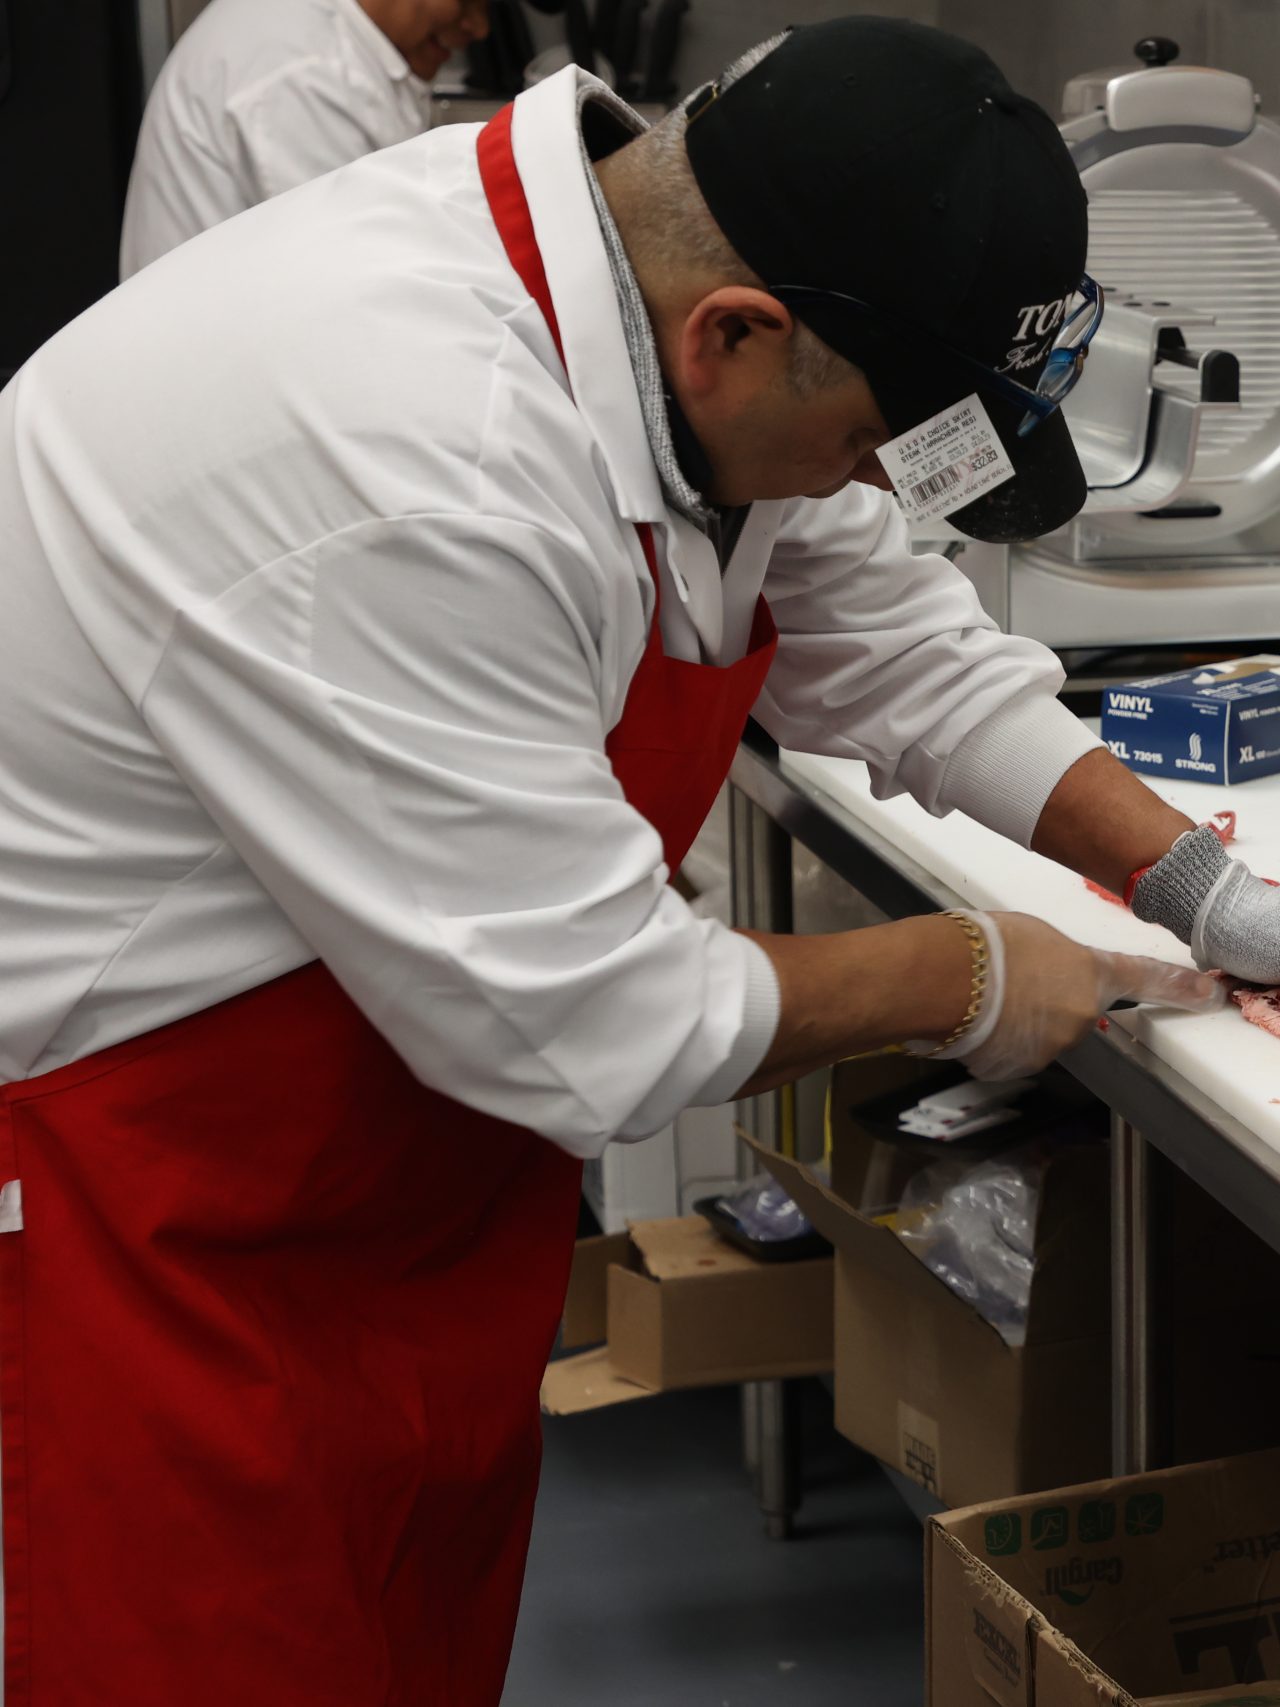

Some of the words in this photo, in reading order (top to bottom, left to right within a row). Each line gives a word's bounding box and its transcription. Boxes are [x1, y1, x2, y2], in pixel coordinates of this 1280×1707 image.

[926, 419, 951, 438] CHOICE
[951, 407, 971, 423] SKIRT
[900, 447, 920, 463] STEAK
[970, 449, 998, 471] $32.83
[1109, 693, 1154, 713] VINYL
[1239, 708, 1259, 721] VINYL
[1108, 740, 1131, 759] XL
[1133, 749, 1164, 764] 73015
[1239, 745, 1255, 764] XL
[1175, 758, 1217, 773] STRONG
[1045, 1556, 1124, 1598] Cargill
